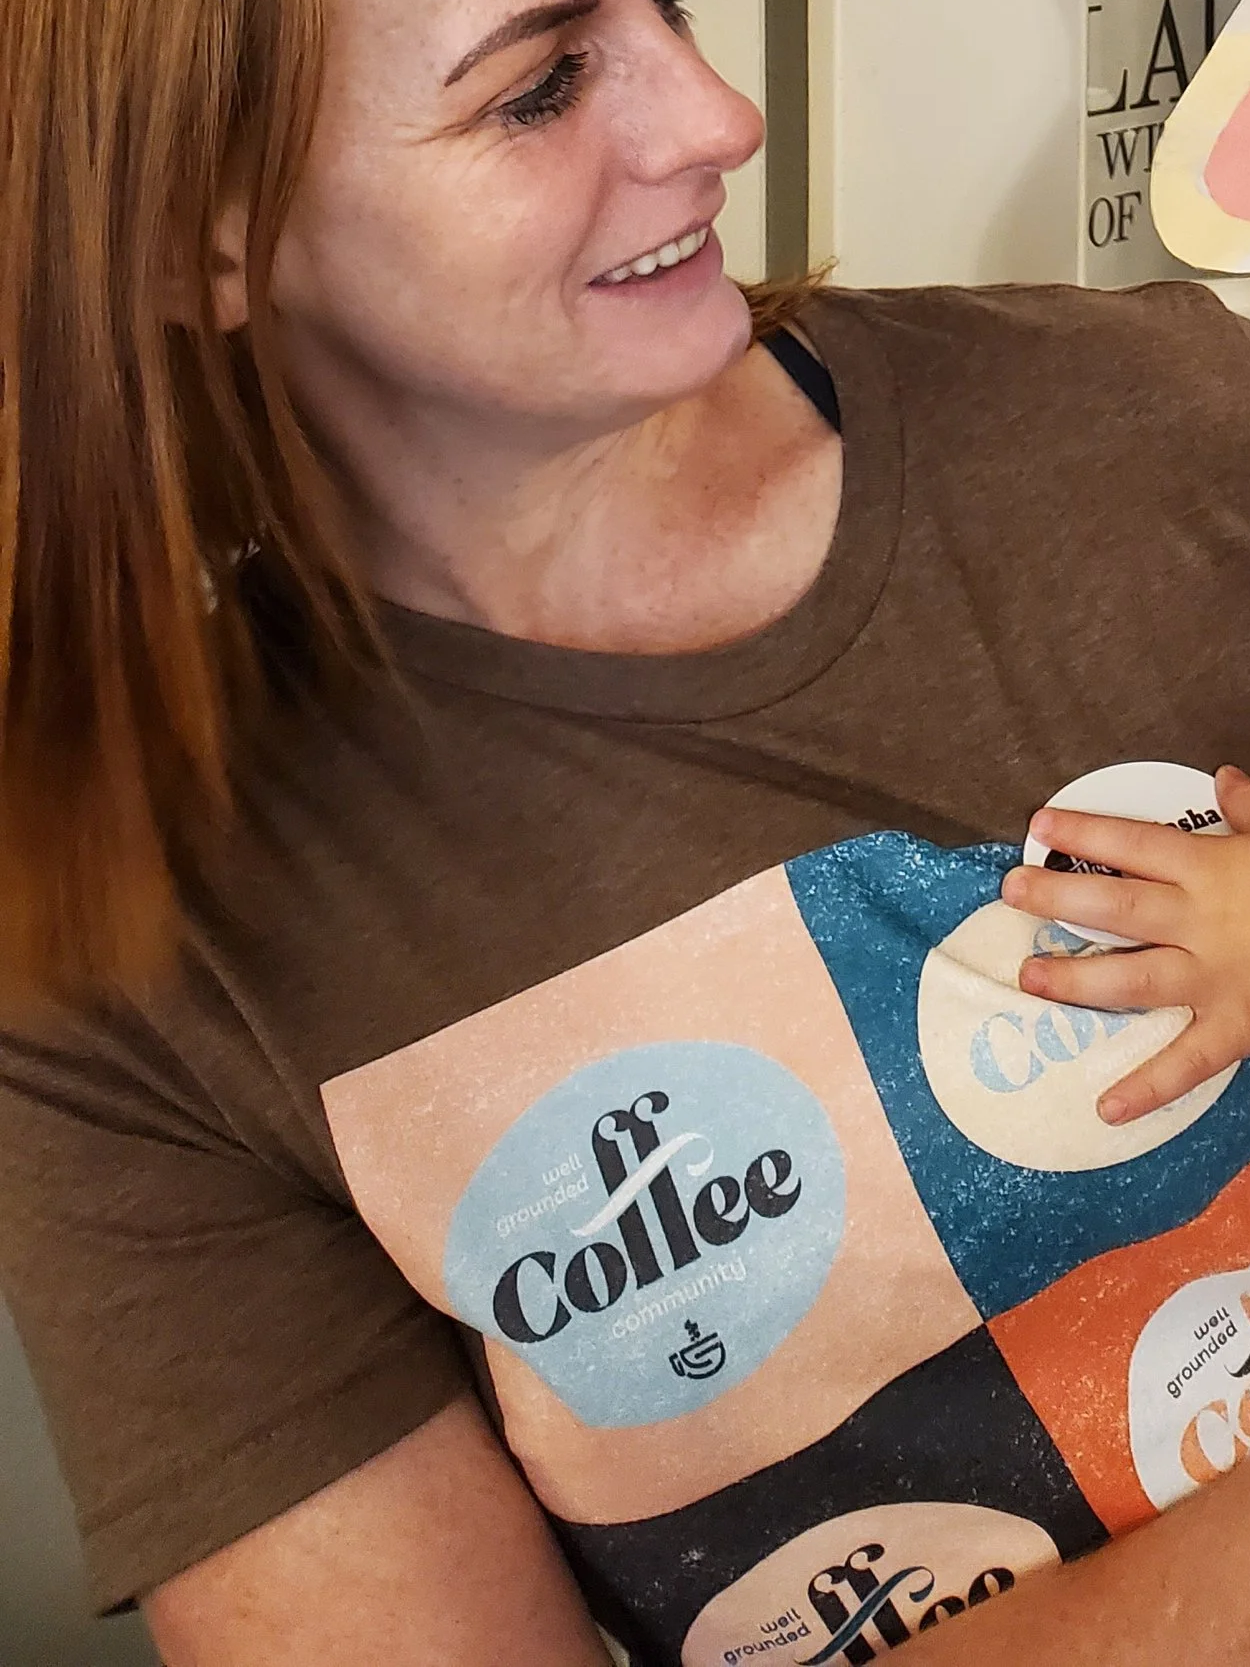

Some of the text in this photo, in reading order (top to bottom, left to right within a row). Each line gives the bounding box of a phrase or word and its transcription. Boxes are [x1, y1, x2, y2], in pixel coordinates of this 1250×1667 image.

[1088, 191, 1142, 248] OF
[1164, 809, 1222, 833] sha
[541, 1153, 584, 1186] well
[492, 1090, 802, 1344] Coffee
[495, 1176, 590, 1238] grounded
[610, 1255, 748, 1339] community
[1193, 1306, 1231, 1341] well
[1166, 1320, 1238, 1399] grounded
[723, 1622, 811, 1666] grounded
[760, 1607, 802, 1636] well
